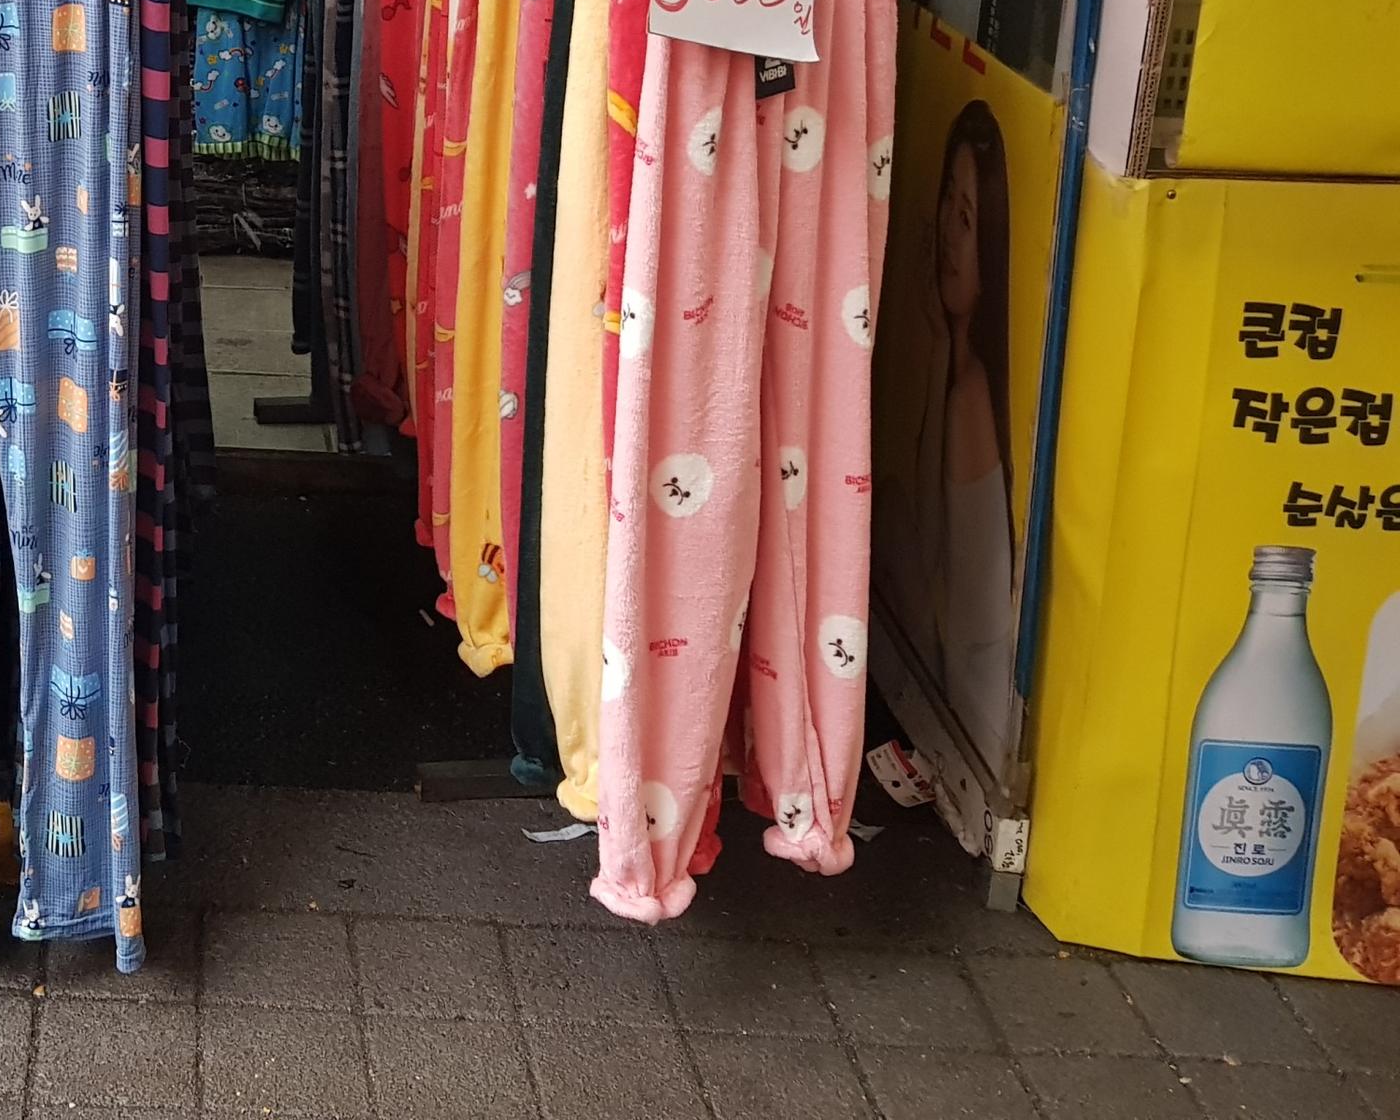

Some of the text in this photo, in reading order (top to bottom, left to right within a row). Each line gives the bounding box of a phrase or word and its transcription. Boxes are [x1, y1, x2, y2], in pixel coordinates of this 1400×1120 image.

[1239, 302, 1342, 359] 큰컵
[1232, 387, 1393, 446] 작은컵
[1221, 855, 1276, 866] JINRO SOJU
